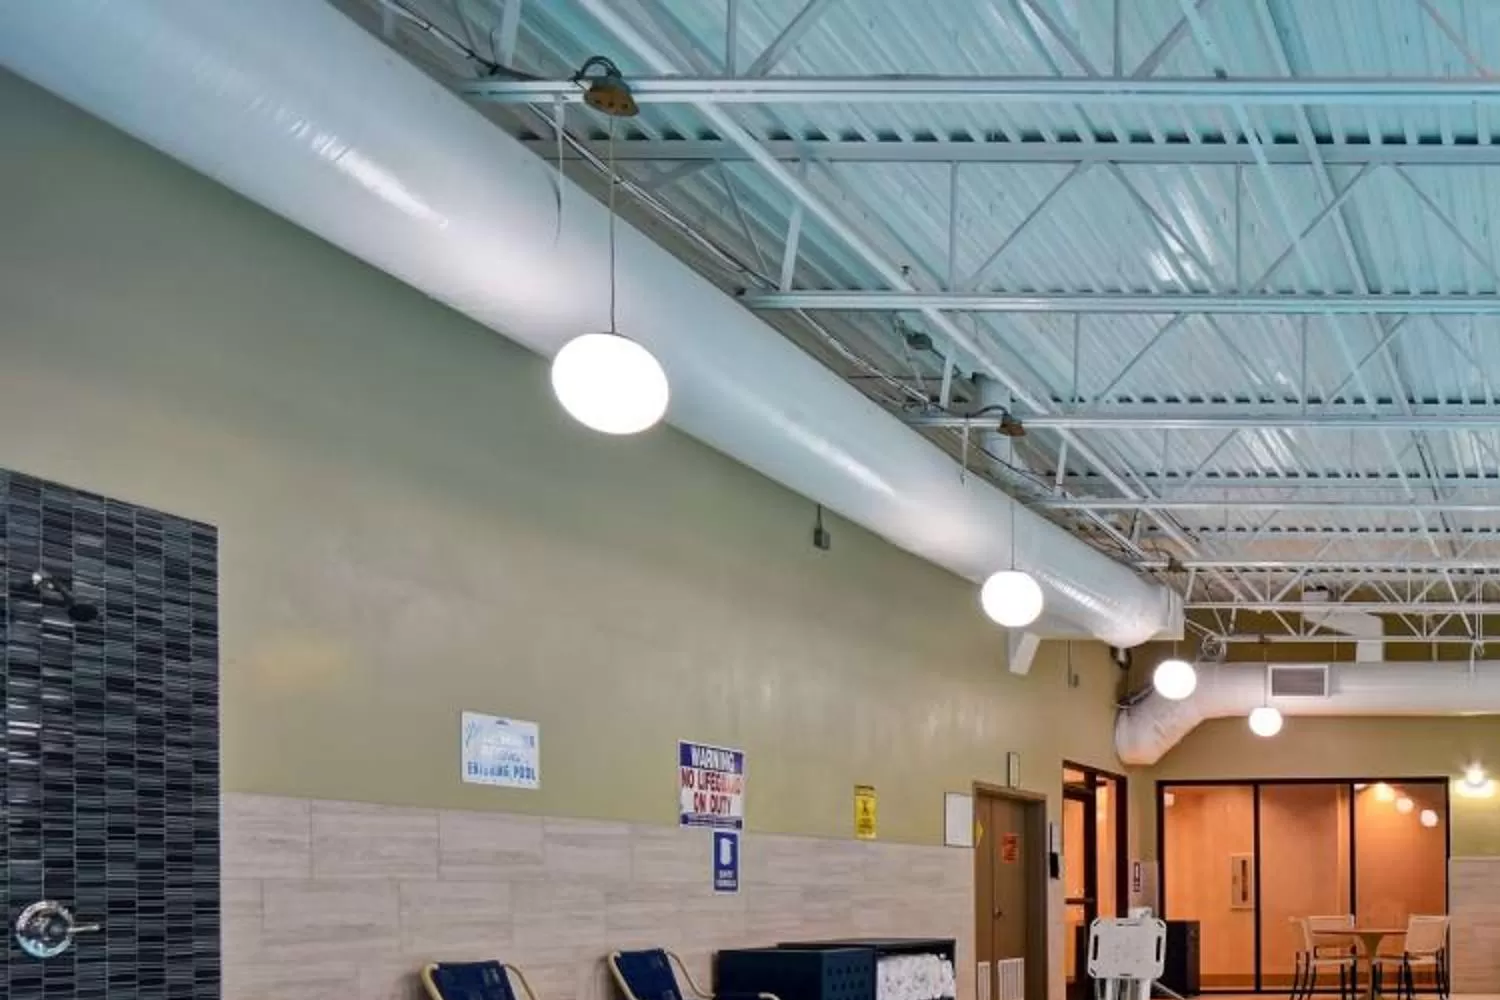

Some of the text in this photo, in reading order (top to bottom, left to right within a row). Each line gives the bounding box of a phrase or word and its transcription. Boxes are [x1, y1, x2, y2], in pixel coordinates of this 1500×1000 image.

[690, 746, 735, 773] WARNING
[681, 768, 695, 789] NO
[693, 792, 731, 816] ON DUTY
